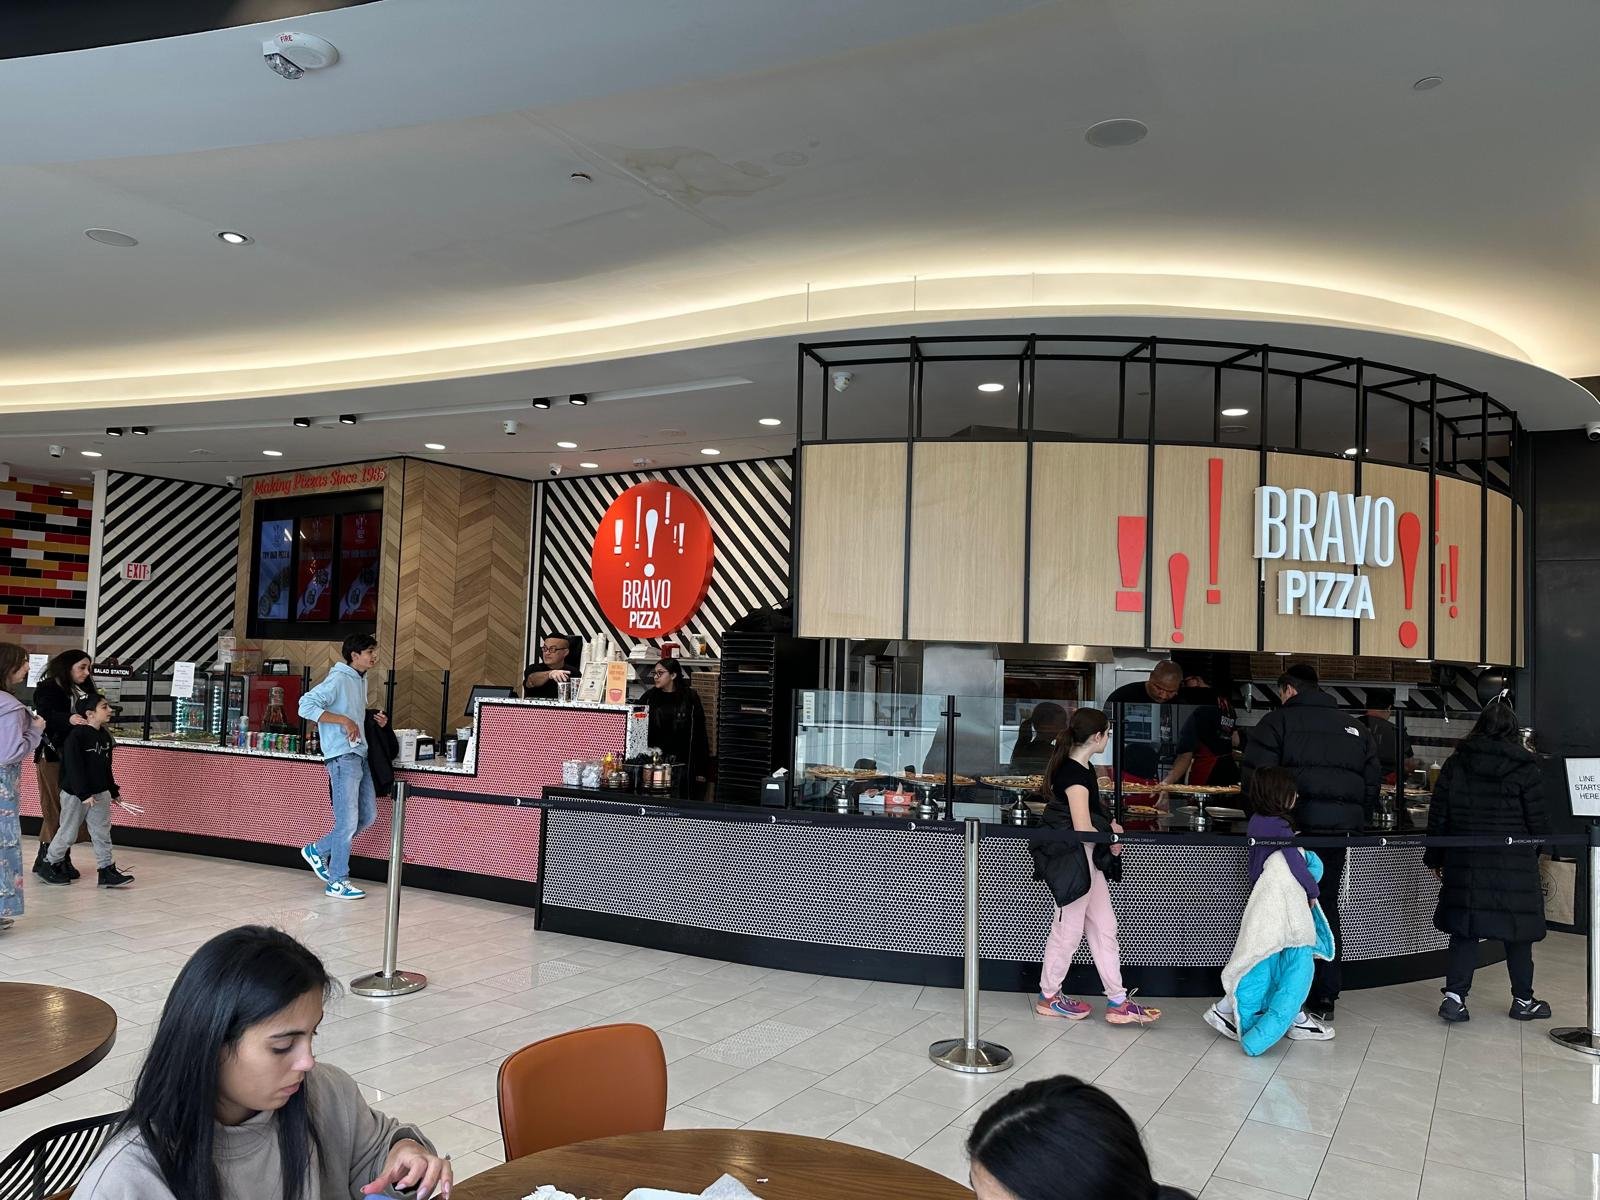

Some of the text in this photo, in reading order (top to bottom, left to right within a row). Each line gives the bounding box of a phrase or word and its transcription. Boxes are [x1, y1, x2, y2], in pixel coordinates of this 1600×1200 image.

[280, 34, 293, 43] FIRE
[253, 477, 292, 496] Making
[292, 473, 328, 491] Pizzas
[329, 469, 358, 486] Since
[1254, 485, 1395, 568] BRAVO
[126, 563, 148, 580] EXIT
[621, 578, 672, 609] BRAVO
[1277, 569, 1376, 620] PIZZA
[628, 610, 662, 630] PIZZA
[1579, 792, 1600, 800] HERE
